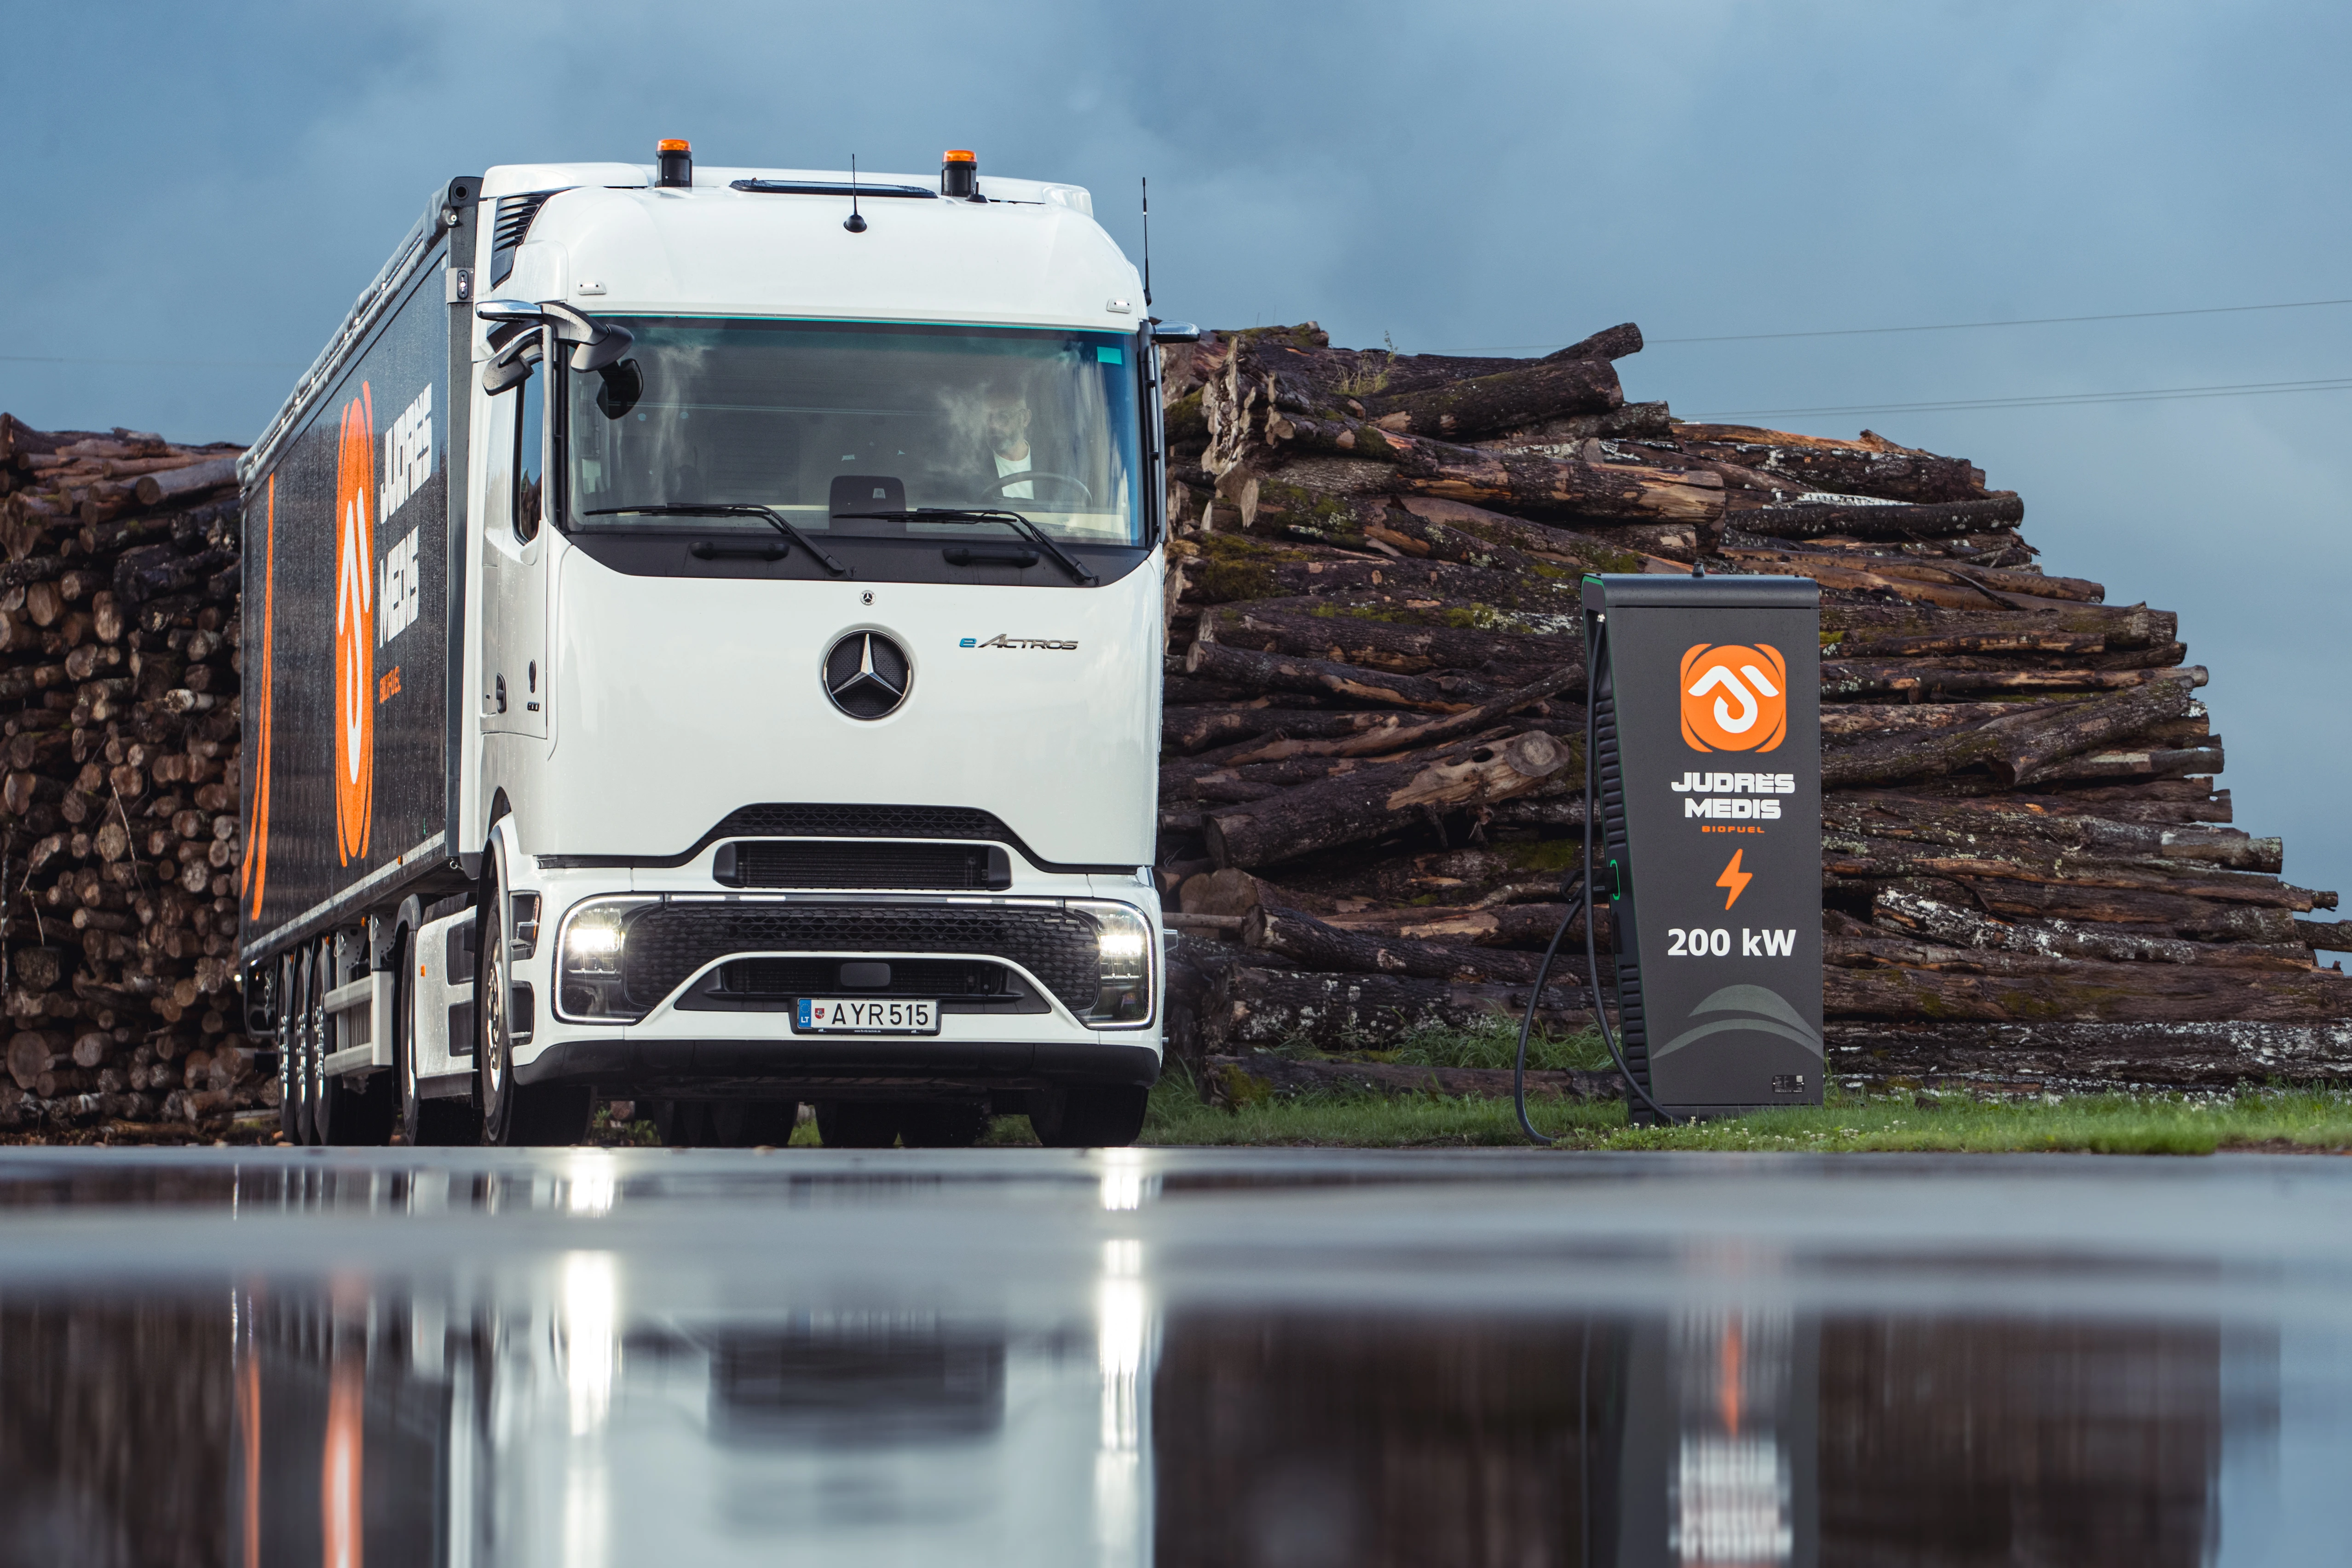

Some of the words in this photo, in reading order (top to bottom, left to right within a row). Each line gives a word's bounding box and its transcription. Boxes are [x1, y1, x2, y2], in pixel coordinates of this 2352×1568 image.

[380, 525, 419, 648] MEDIS
[1684, 798, 1781, 819] MEDIS
[1667, 928, 1730, 957] 200
[1742, 928, 1797, 957] kW
